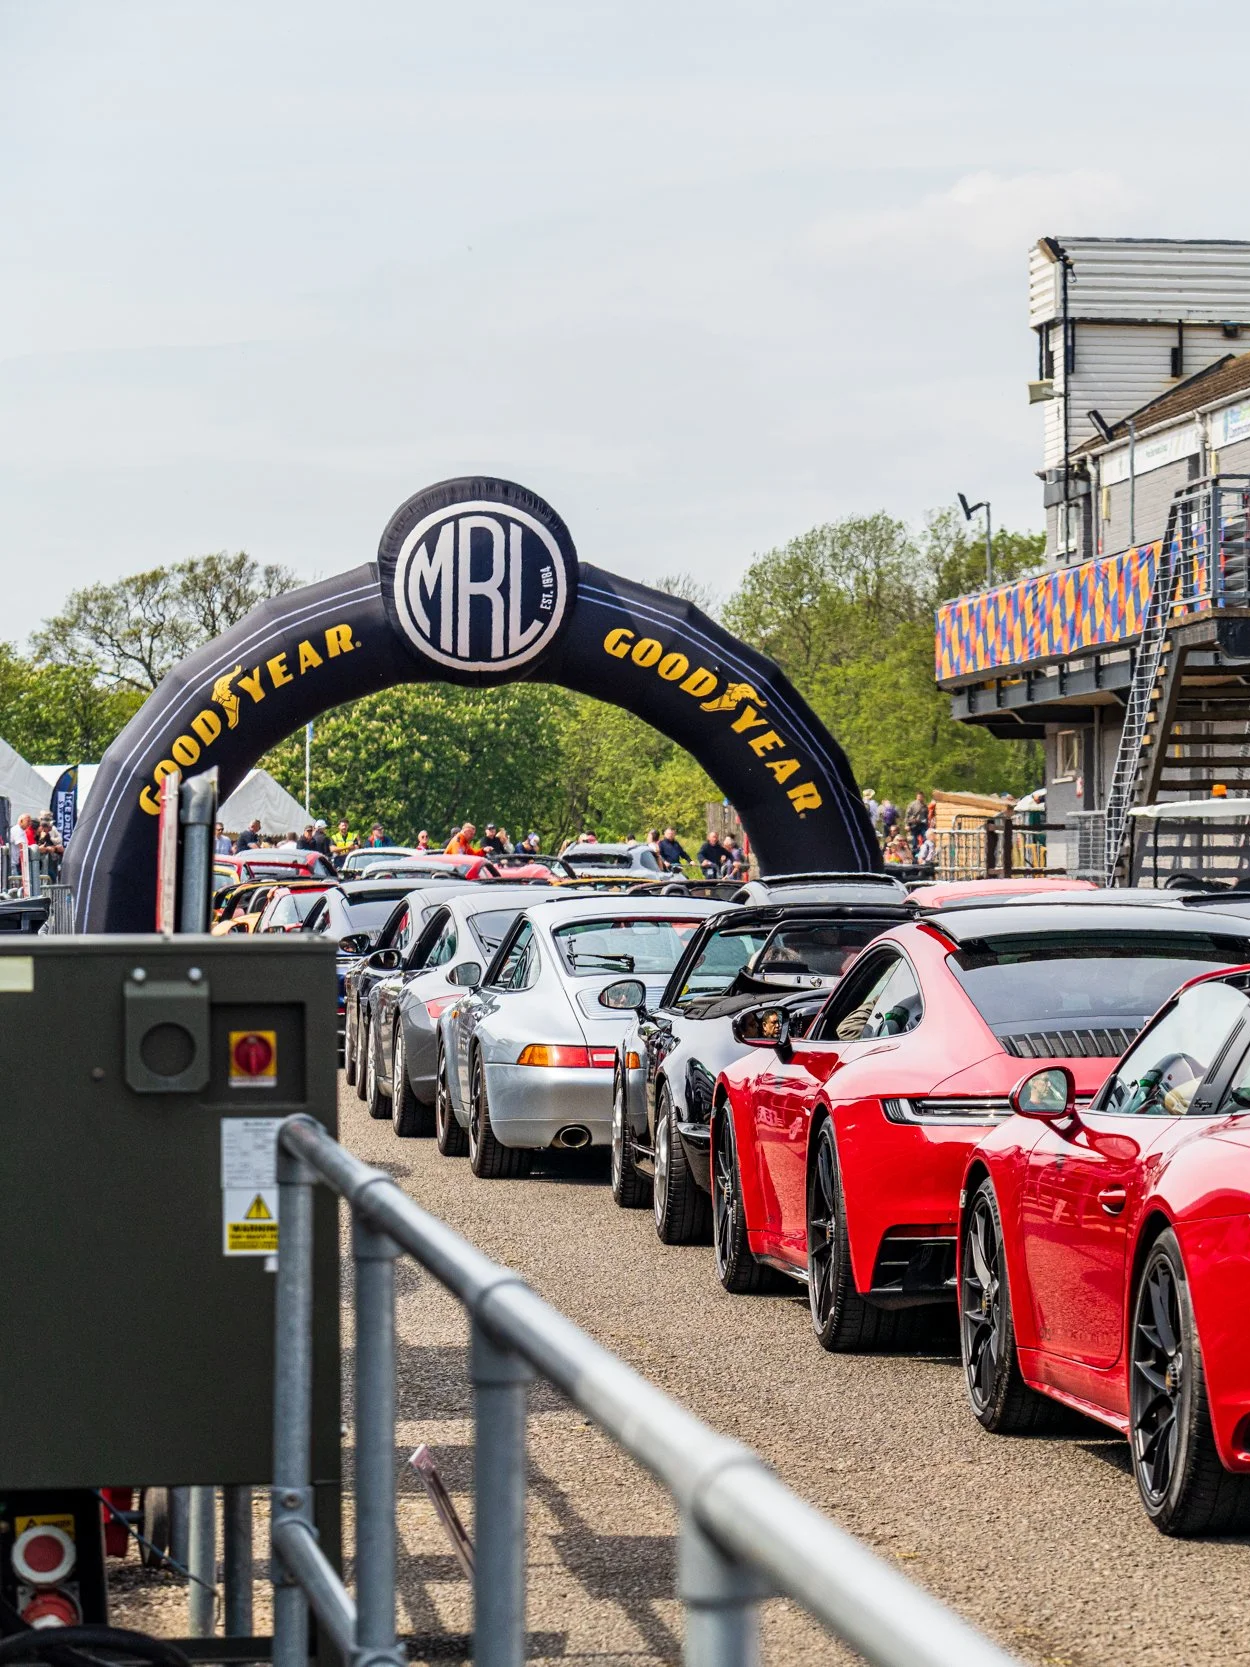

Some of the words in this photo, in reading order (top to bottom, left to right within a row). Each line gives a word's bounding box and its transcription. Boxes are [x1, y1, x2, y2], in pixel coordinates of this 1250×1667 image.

[408, 516, 544, 658] MRL
[540, 565, 553, 588] 1984
[540, 590, 553, 610] EST.
[140, 624, 355, 815] GOODYEAR
[604, 628, 822, 813] GOODYEAR
